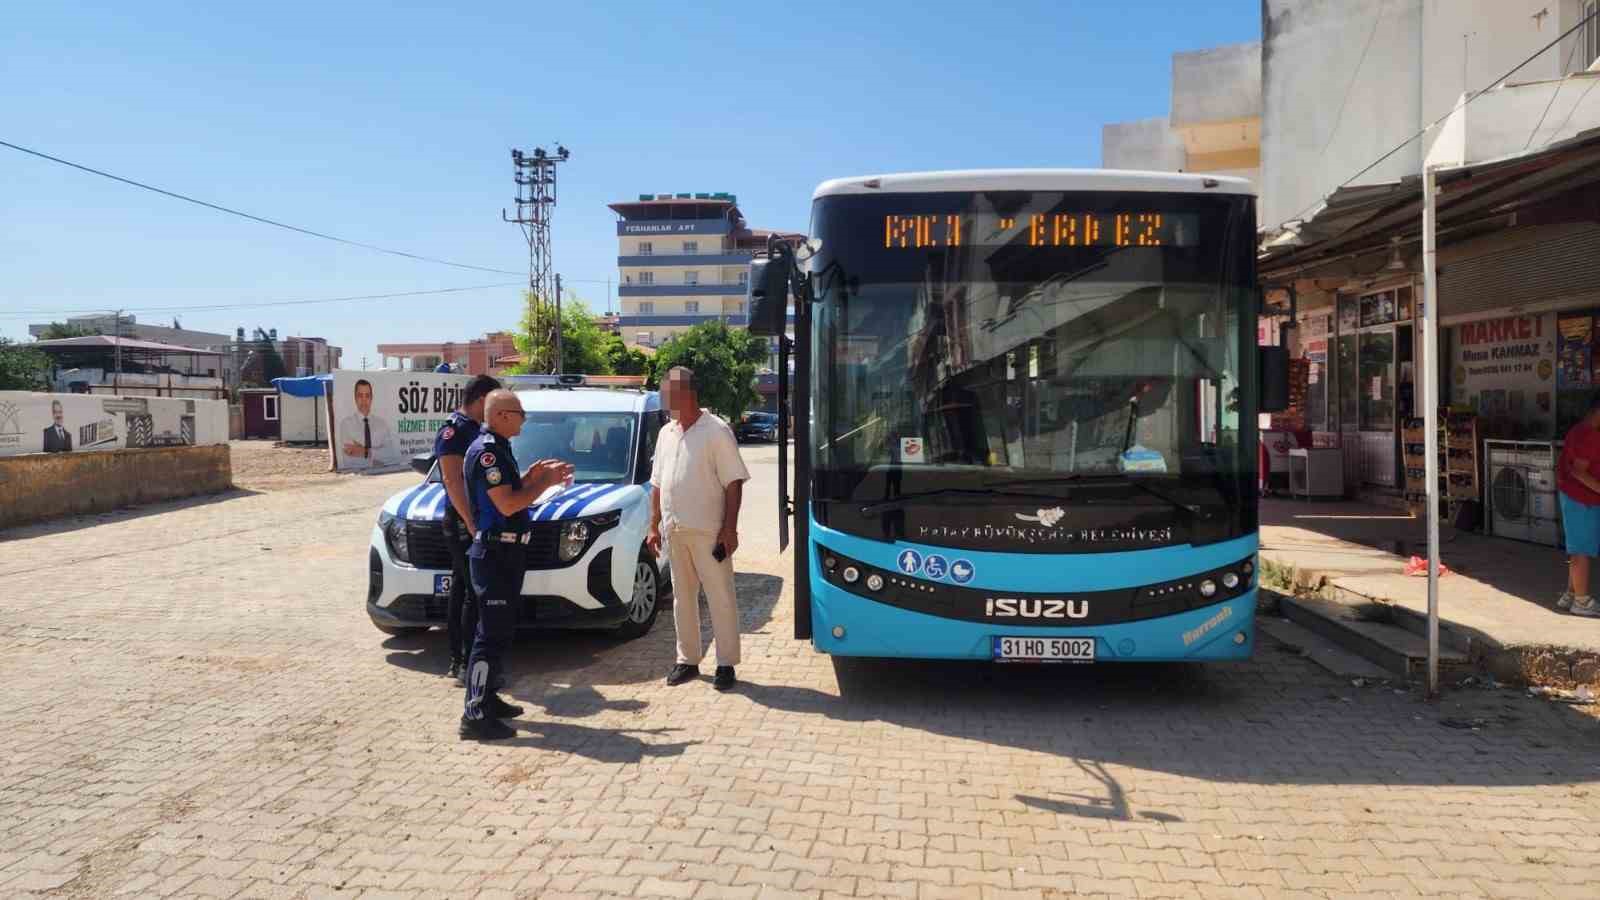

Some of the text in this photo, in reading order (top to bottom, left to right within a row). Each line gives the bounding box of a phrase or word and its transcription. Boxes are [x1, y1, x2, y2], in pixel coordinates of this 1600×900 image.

[1460, 318, 1543, 345] MARKET
[398, 381, 428, 414] SÖZ
[398, 417, 426, 433] HİZMET
[985, 598, 1089, 618] ISUZU
[1002, 640, 1020, 656] 31
[1050, 640, 1092, 656] 5002
